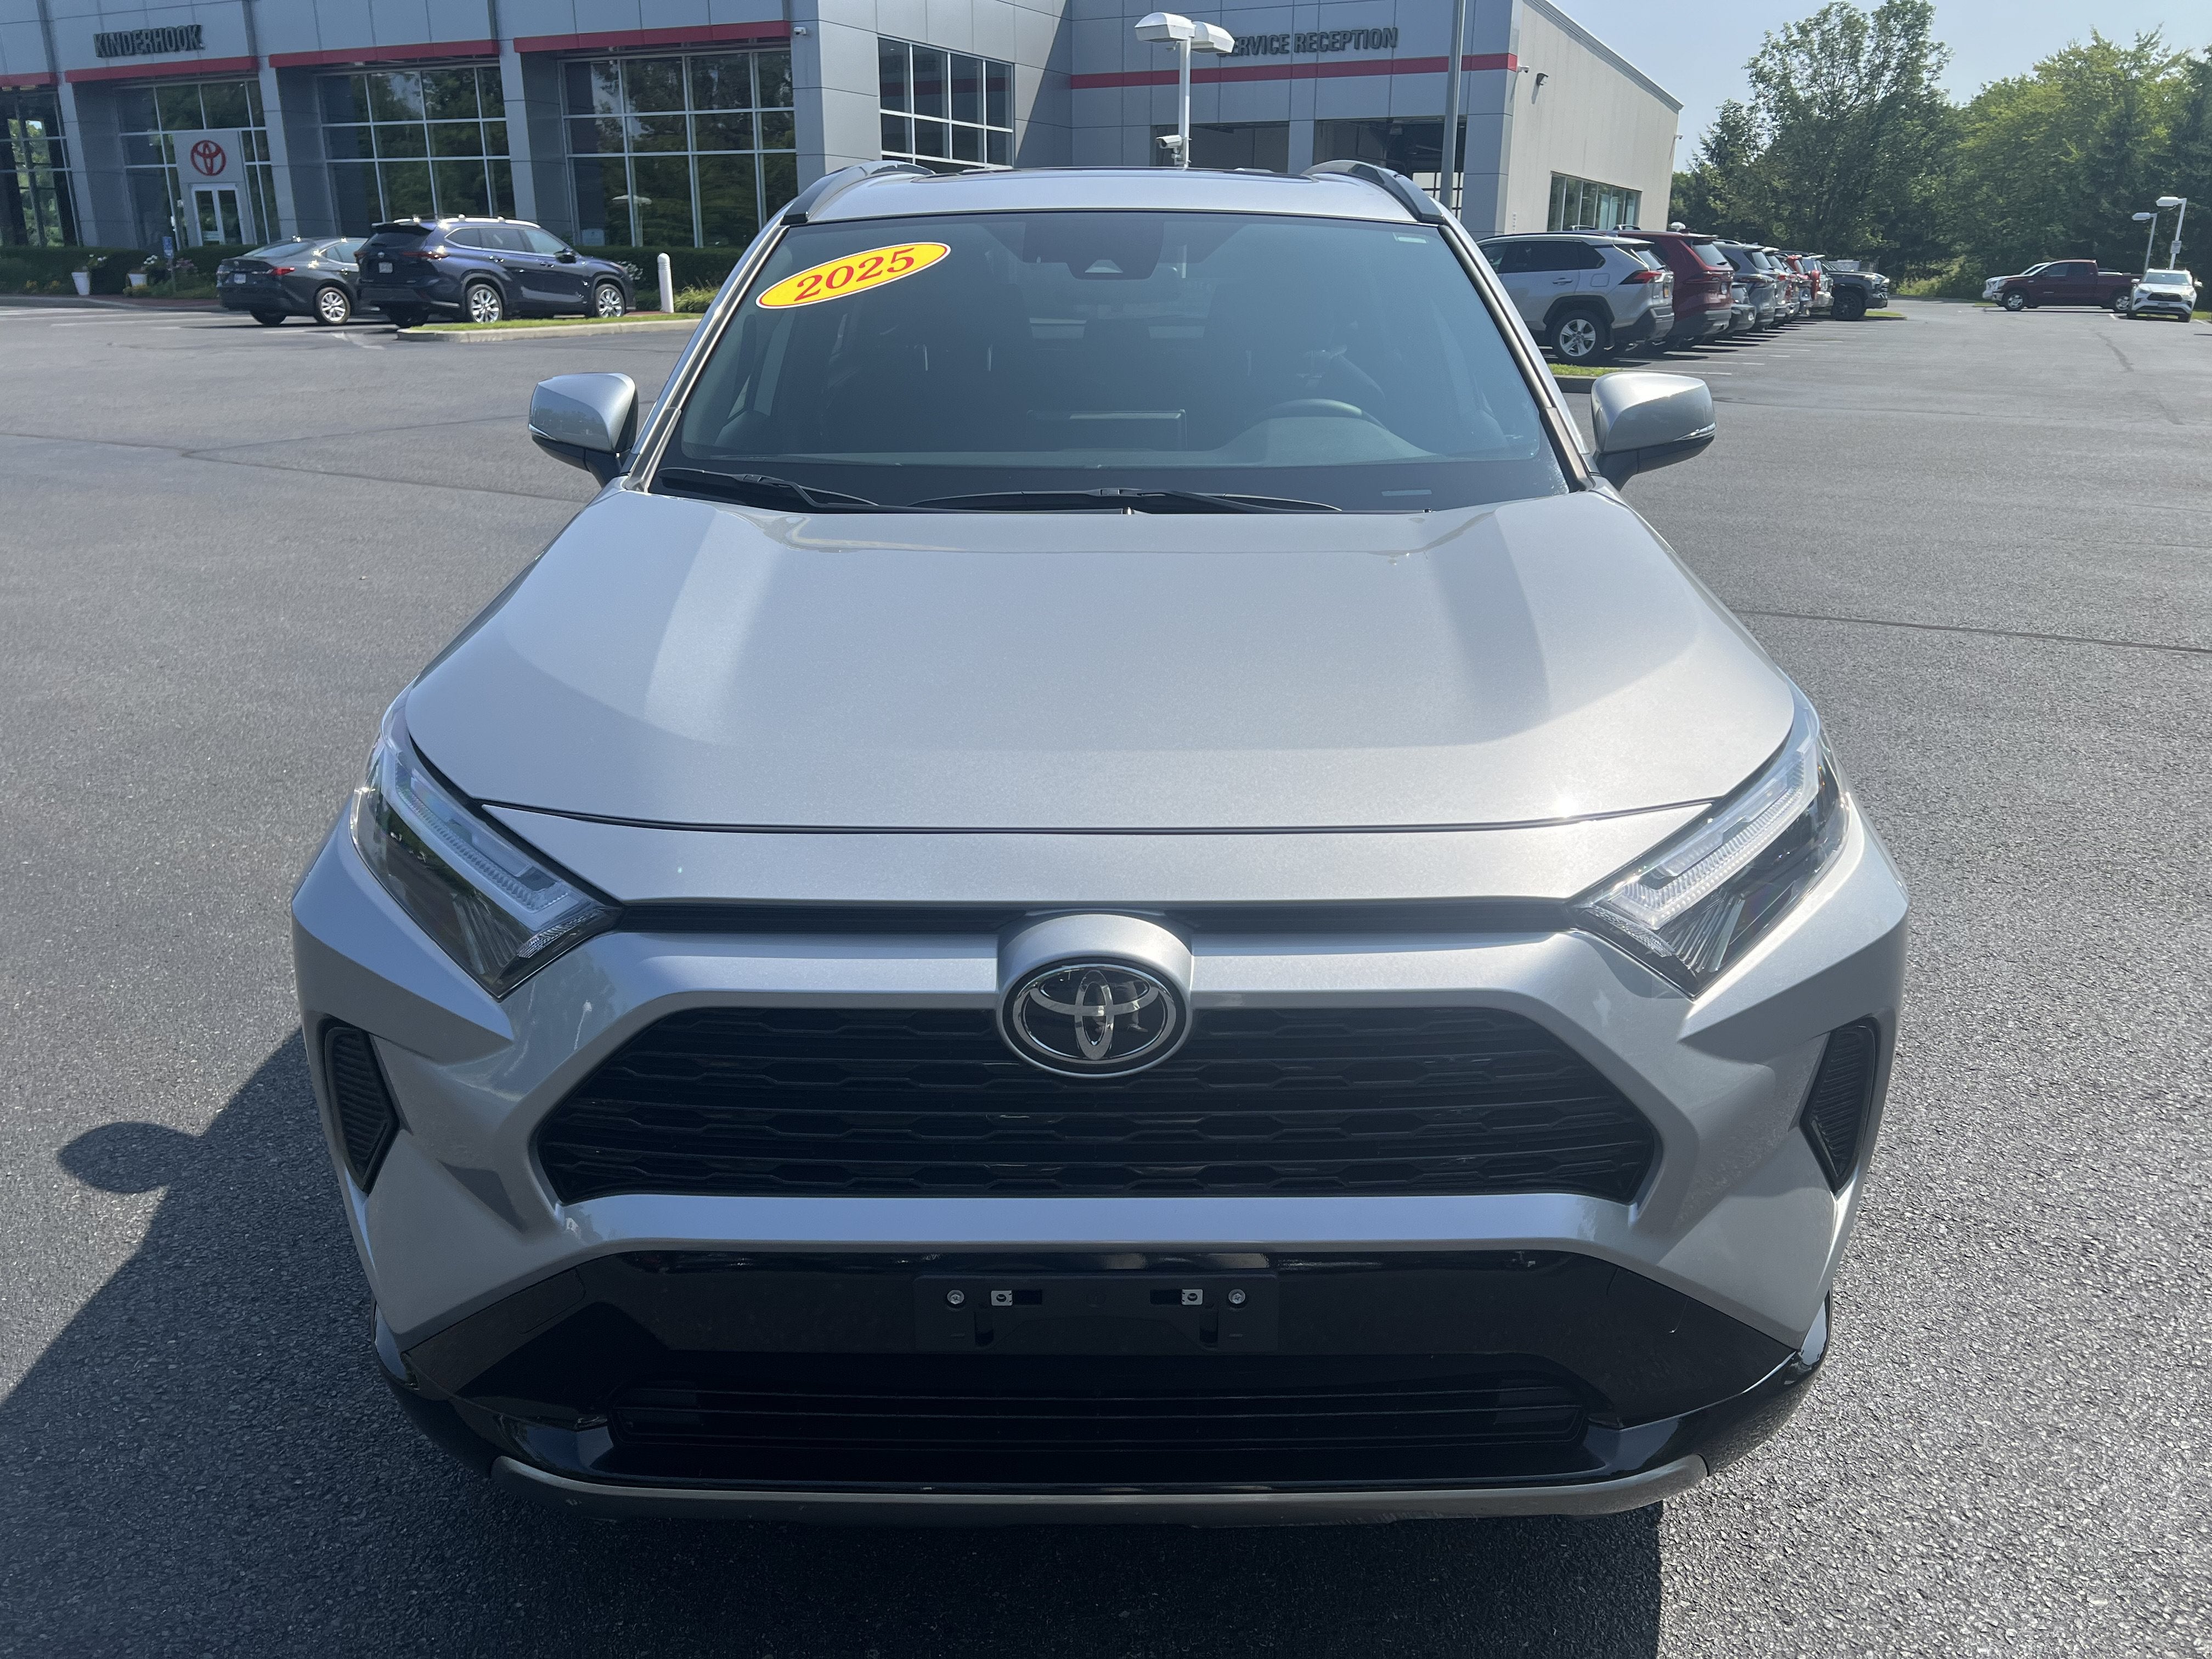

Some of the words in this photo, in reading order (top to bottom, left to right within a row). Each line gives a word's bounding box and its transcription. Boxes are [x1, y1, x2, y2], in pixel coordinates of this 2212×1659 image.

[94, 25, 204, 58] KINDERHOOK
[1217, 34, 1289, 57] ERVICE
[1294, 27, 1398, 53] RECEPTION
[793, 247, 915, 302] 2025
